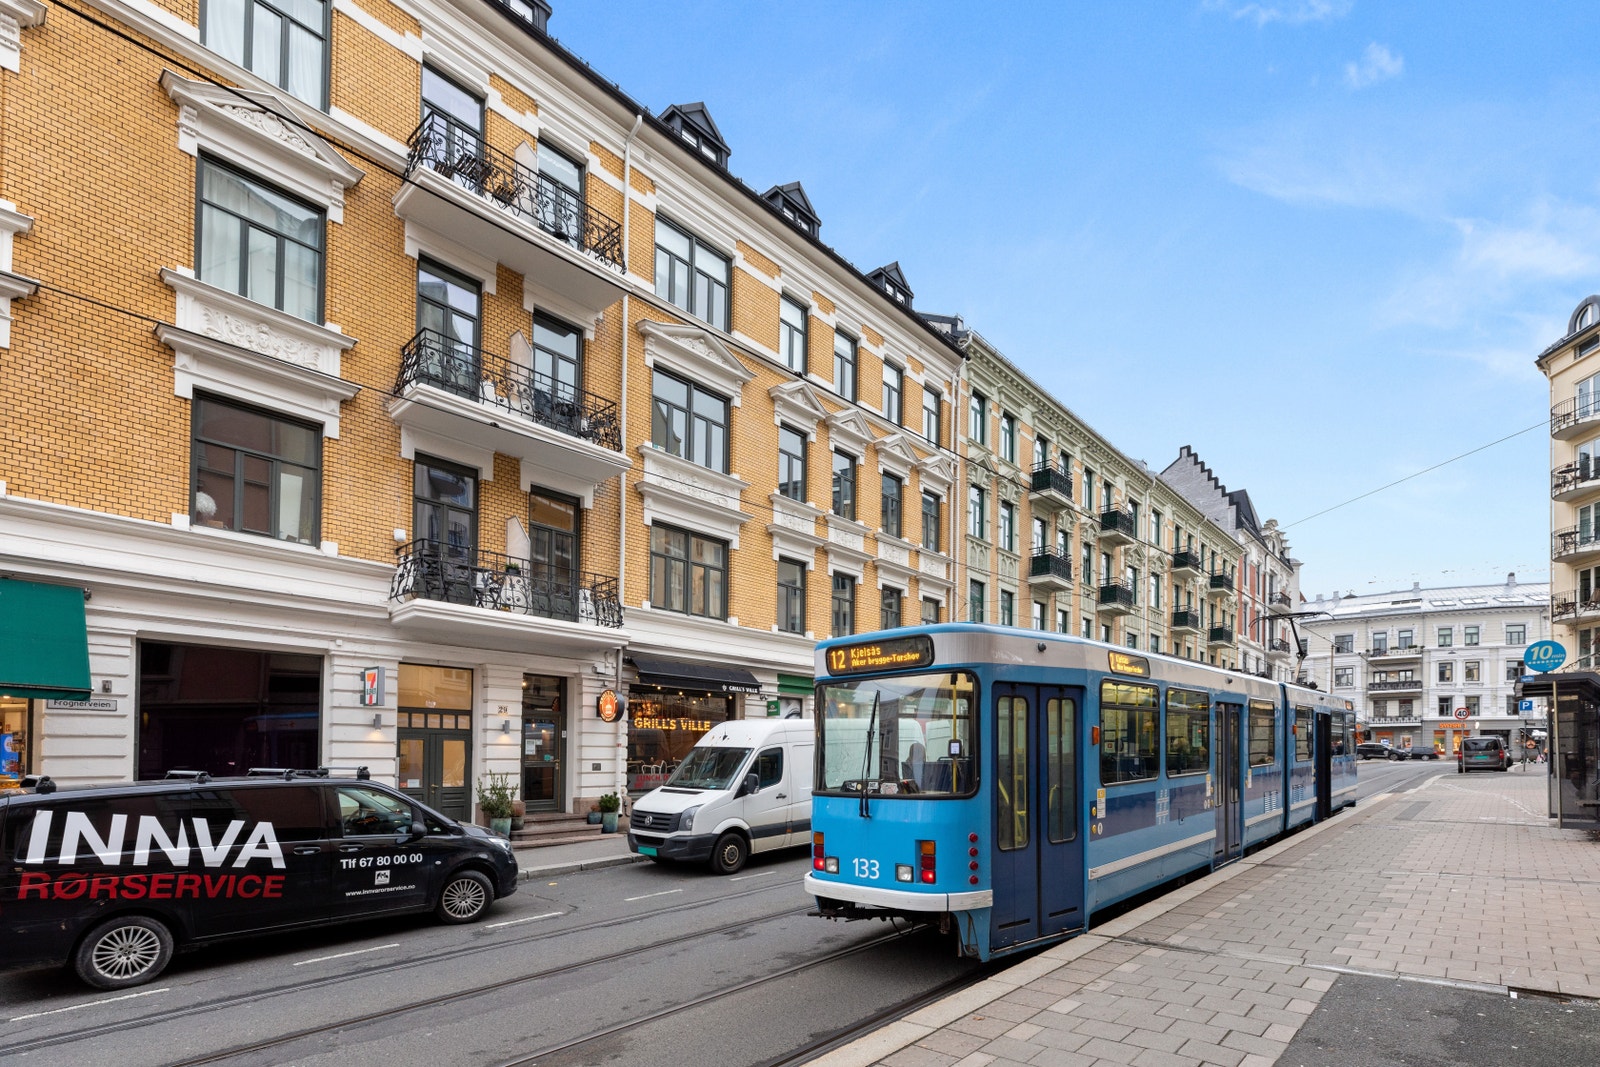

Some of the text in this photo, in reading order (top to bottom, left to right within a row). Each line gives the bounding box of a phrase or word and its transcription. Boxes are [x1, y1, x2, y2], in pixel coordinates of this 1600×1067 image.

[830, 646, 881, 670] 12 Kjelsås
[1531, 645, 1553, 661] 10
[497, 705, 508, 714] 29
[634, 717, 711, 731] GRILL'S VILLE
[25, 810, 286, 869] INNVA
[359, 857, 374, 868] 67
[376, 856, 391, 866] 80
[393, 854, 407, 864] 00
[409, 853, 423, 863] 00
[852, 857, 880, 880] 133
[17, 871, 287, 900] RØRSERVICE
